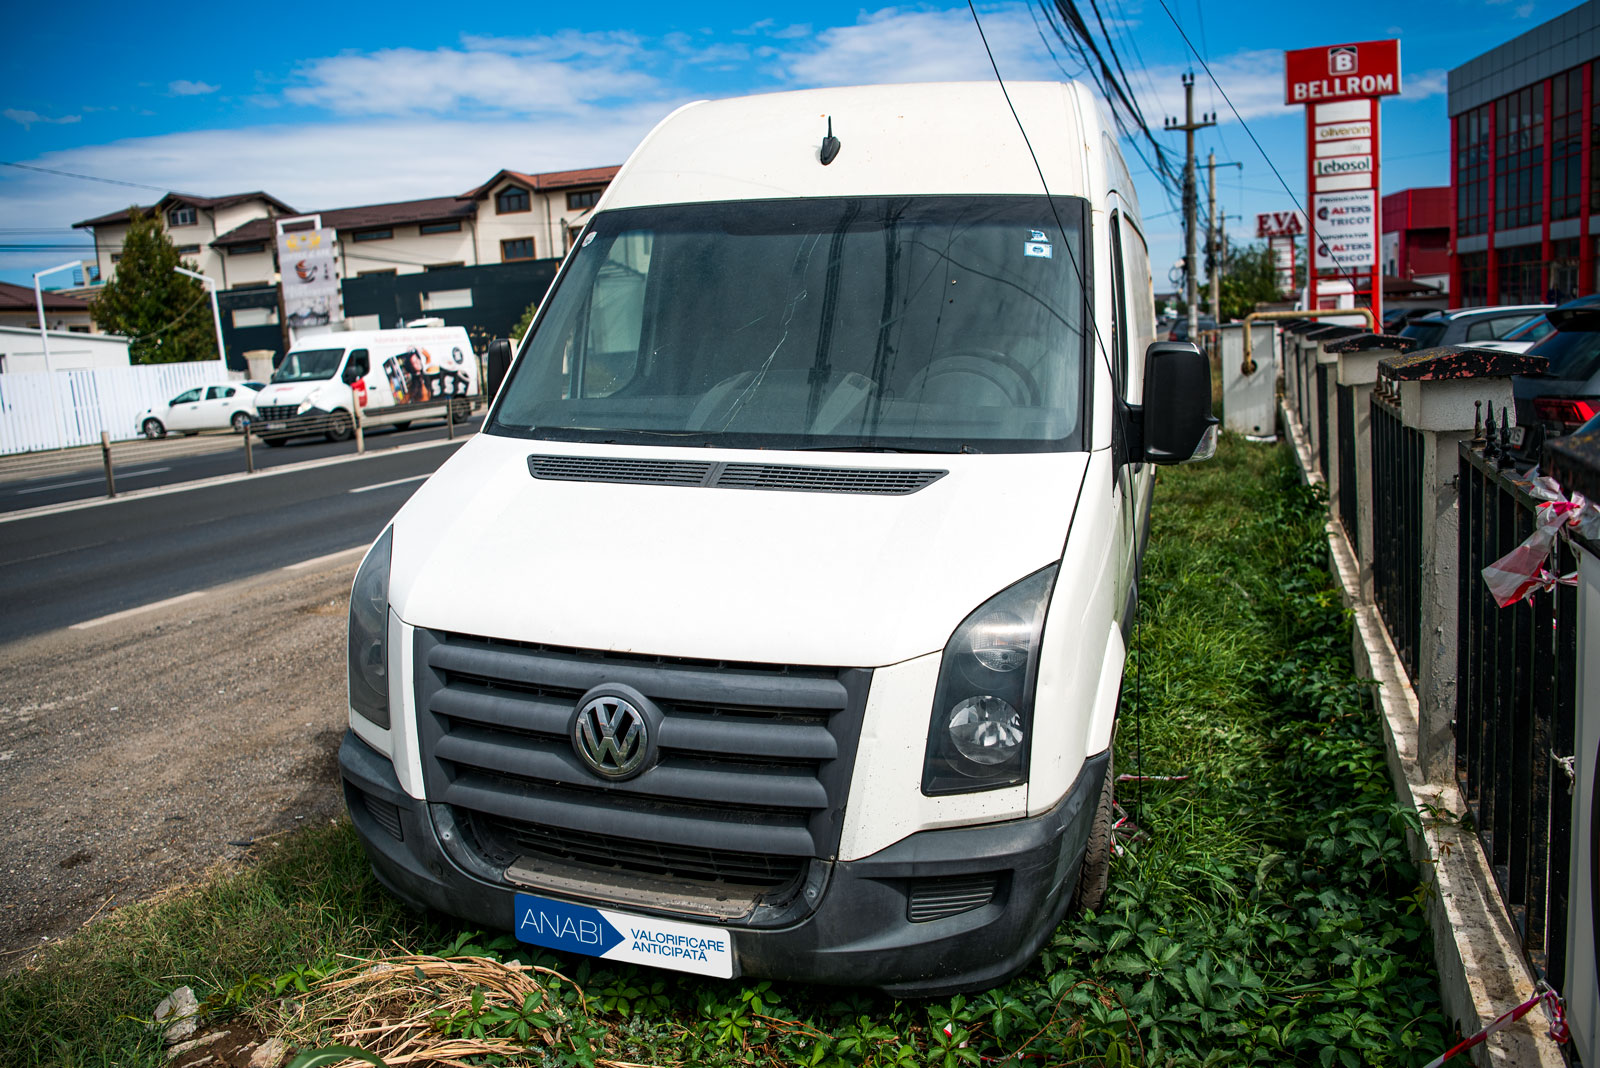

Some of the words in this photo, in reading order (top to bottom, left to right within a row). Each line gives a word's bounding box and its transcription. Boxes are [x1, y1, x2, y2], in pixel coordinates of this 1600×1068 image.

[1336, 54, 1352, 71] B
[1294, 73, 1393, 101] BELLROM
[1257, 212, 1302, 232] EVA
[1330, 217, 1371, 226] TRICOT
[520, 908, 603, 946] ANABI
[630, 928, 725, 953] VALORIFICARE
[631, 941, 708, 962] ANTICIPATĂ
